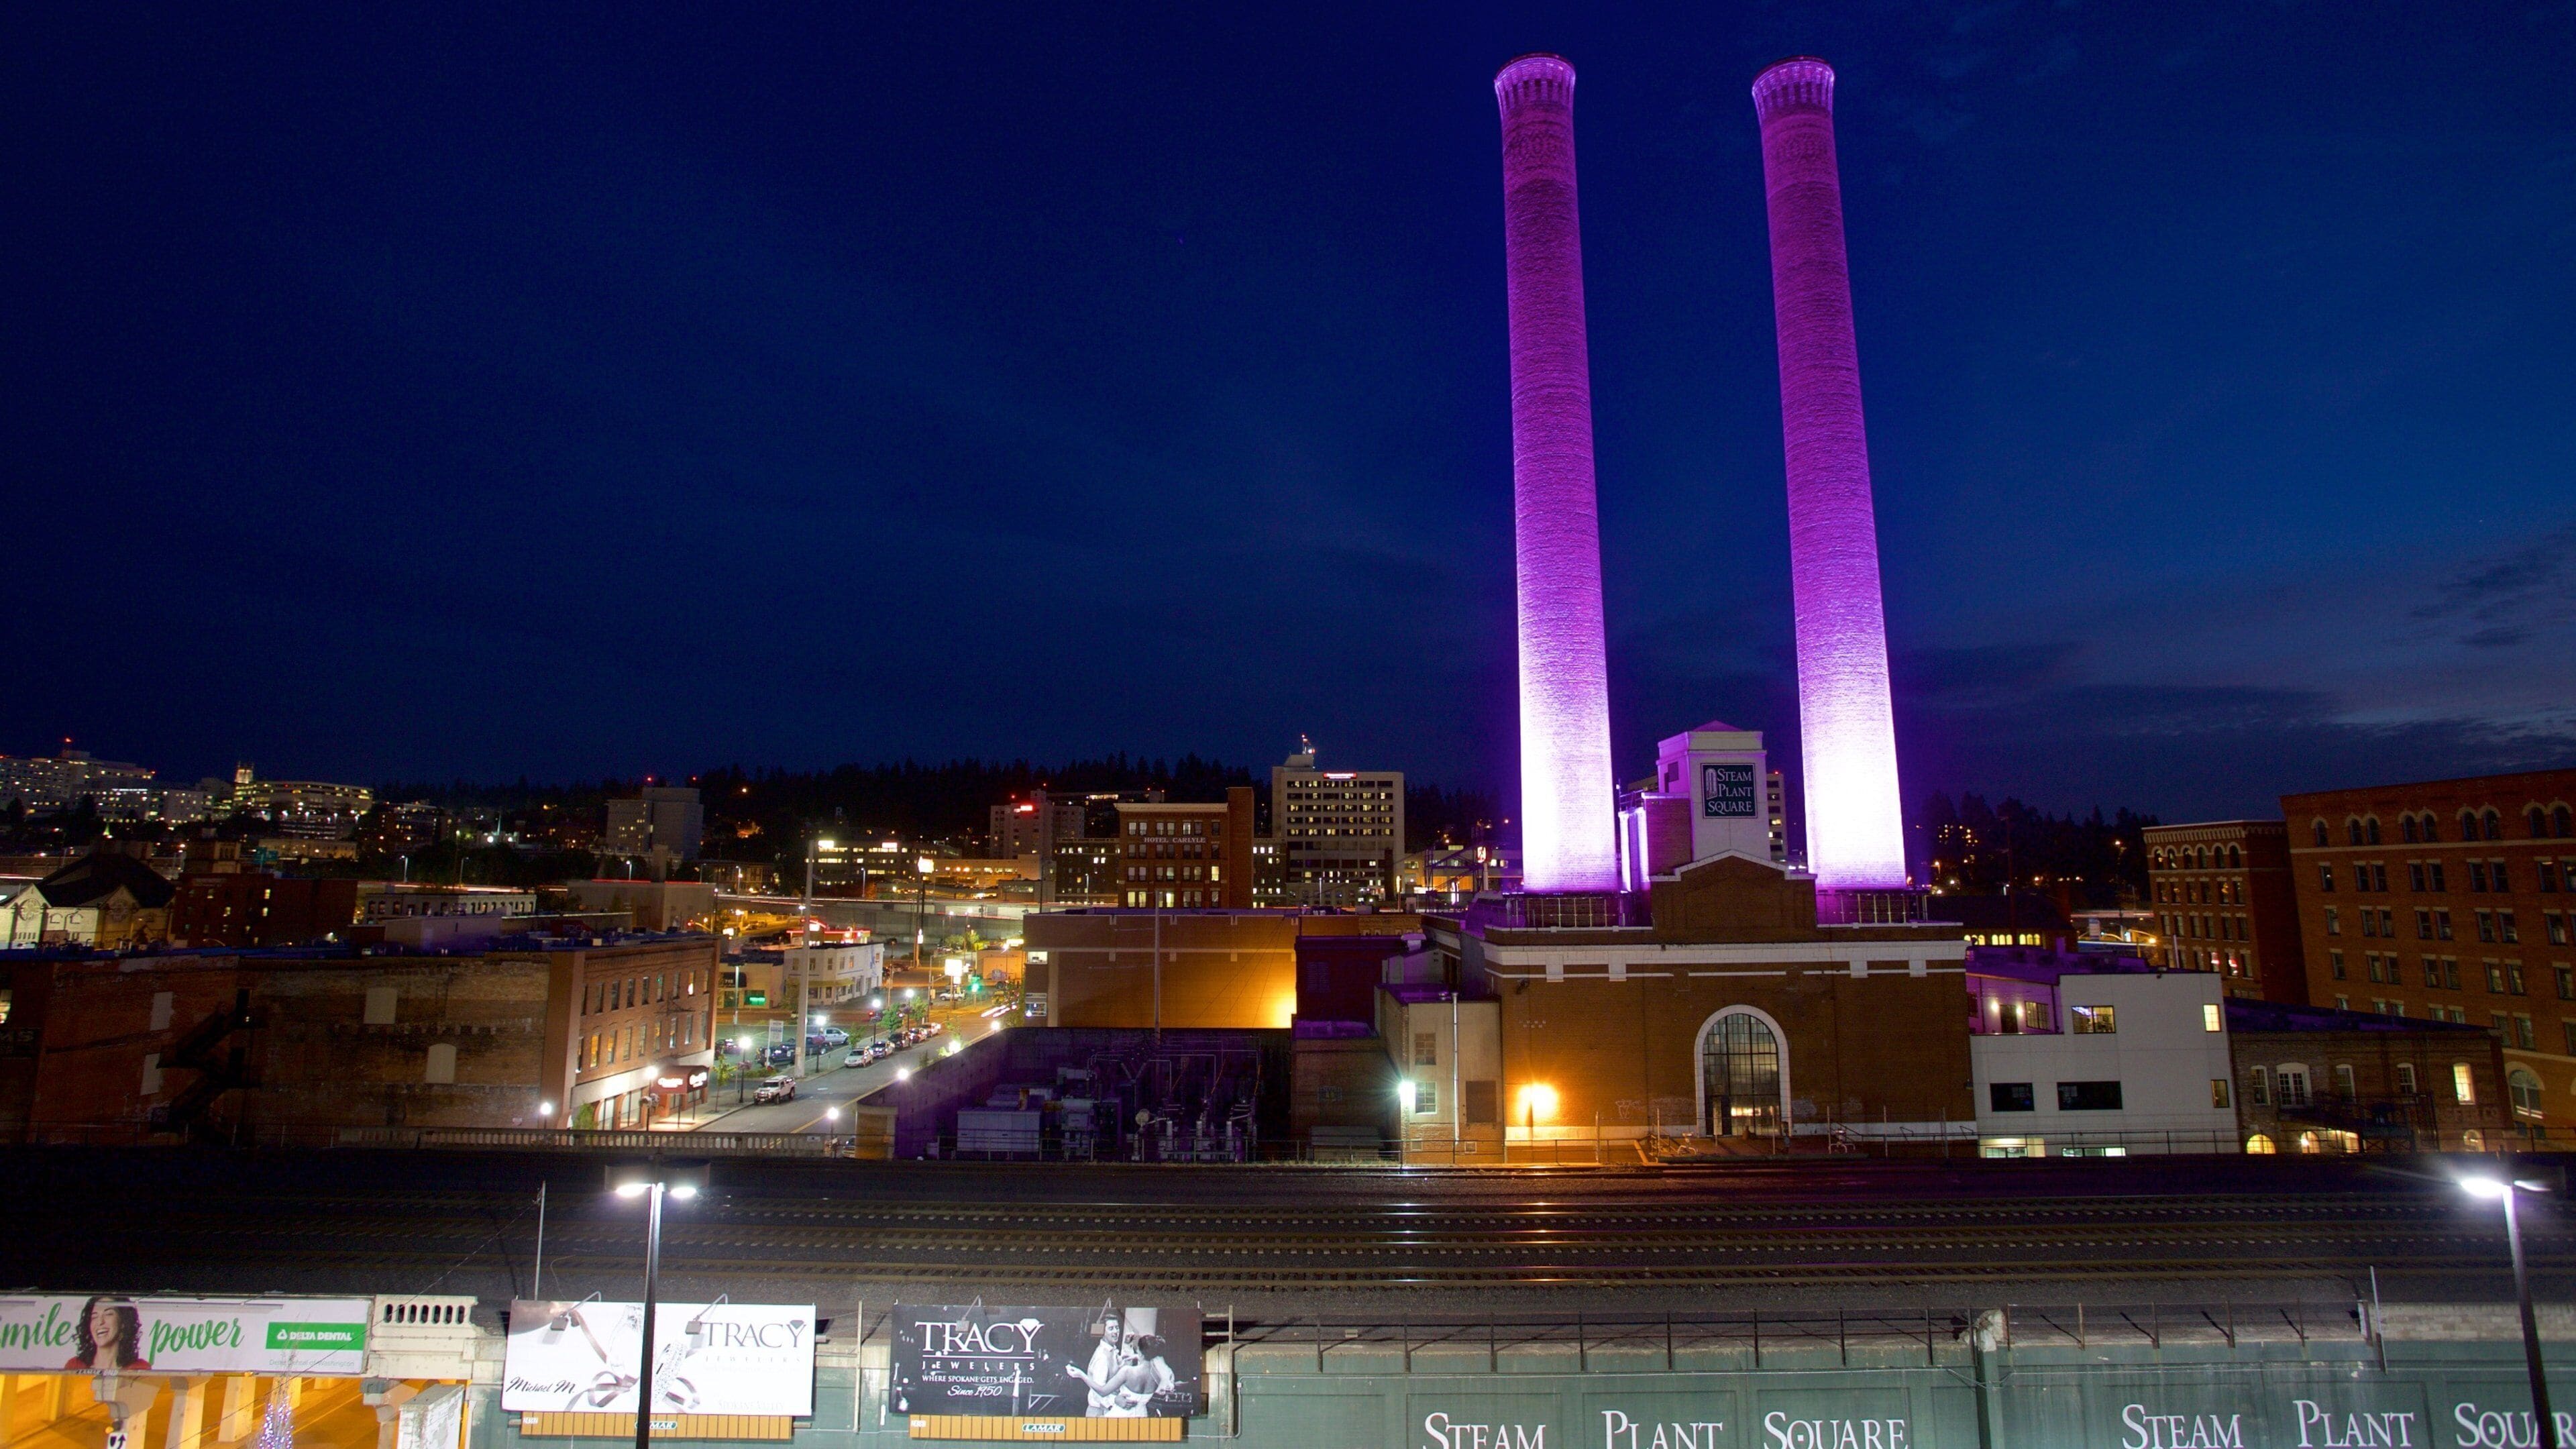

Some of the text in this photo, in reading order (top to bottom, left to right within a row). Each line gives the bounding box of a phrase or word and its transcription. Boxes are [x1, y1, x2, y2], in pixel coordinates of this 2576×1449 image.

[1717, 768, 1752, 782] STEAM
[1718, 784, 1753, 797] PLANT
[1708, 800, 1753, 815] SQUARE
[0, 1302, 245, 1365] mile power
[289, 1331, 353, 1341] DELTA DENTAL
[700, 1319, 807, 1349] TRACY
[914, 1319, 1044, 1353] TRACY
[921, 1360, 1035, 1371] JEWELERS
[506, 1377, 554, 1393] Michael
[922, 1375, 947, 1383] WHERE
[947, 1385, 1002, 1397] Since 1950
[1423, 1409, 1907, 1449] STEAM PLANT SQUARE
[2121, 1403, 2245, 1449] STEAM
[2293, 1399, 2415, 1448] PLANT
